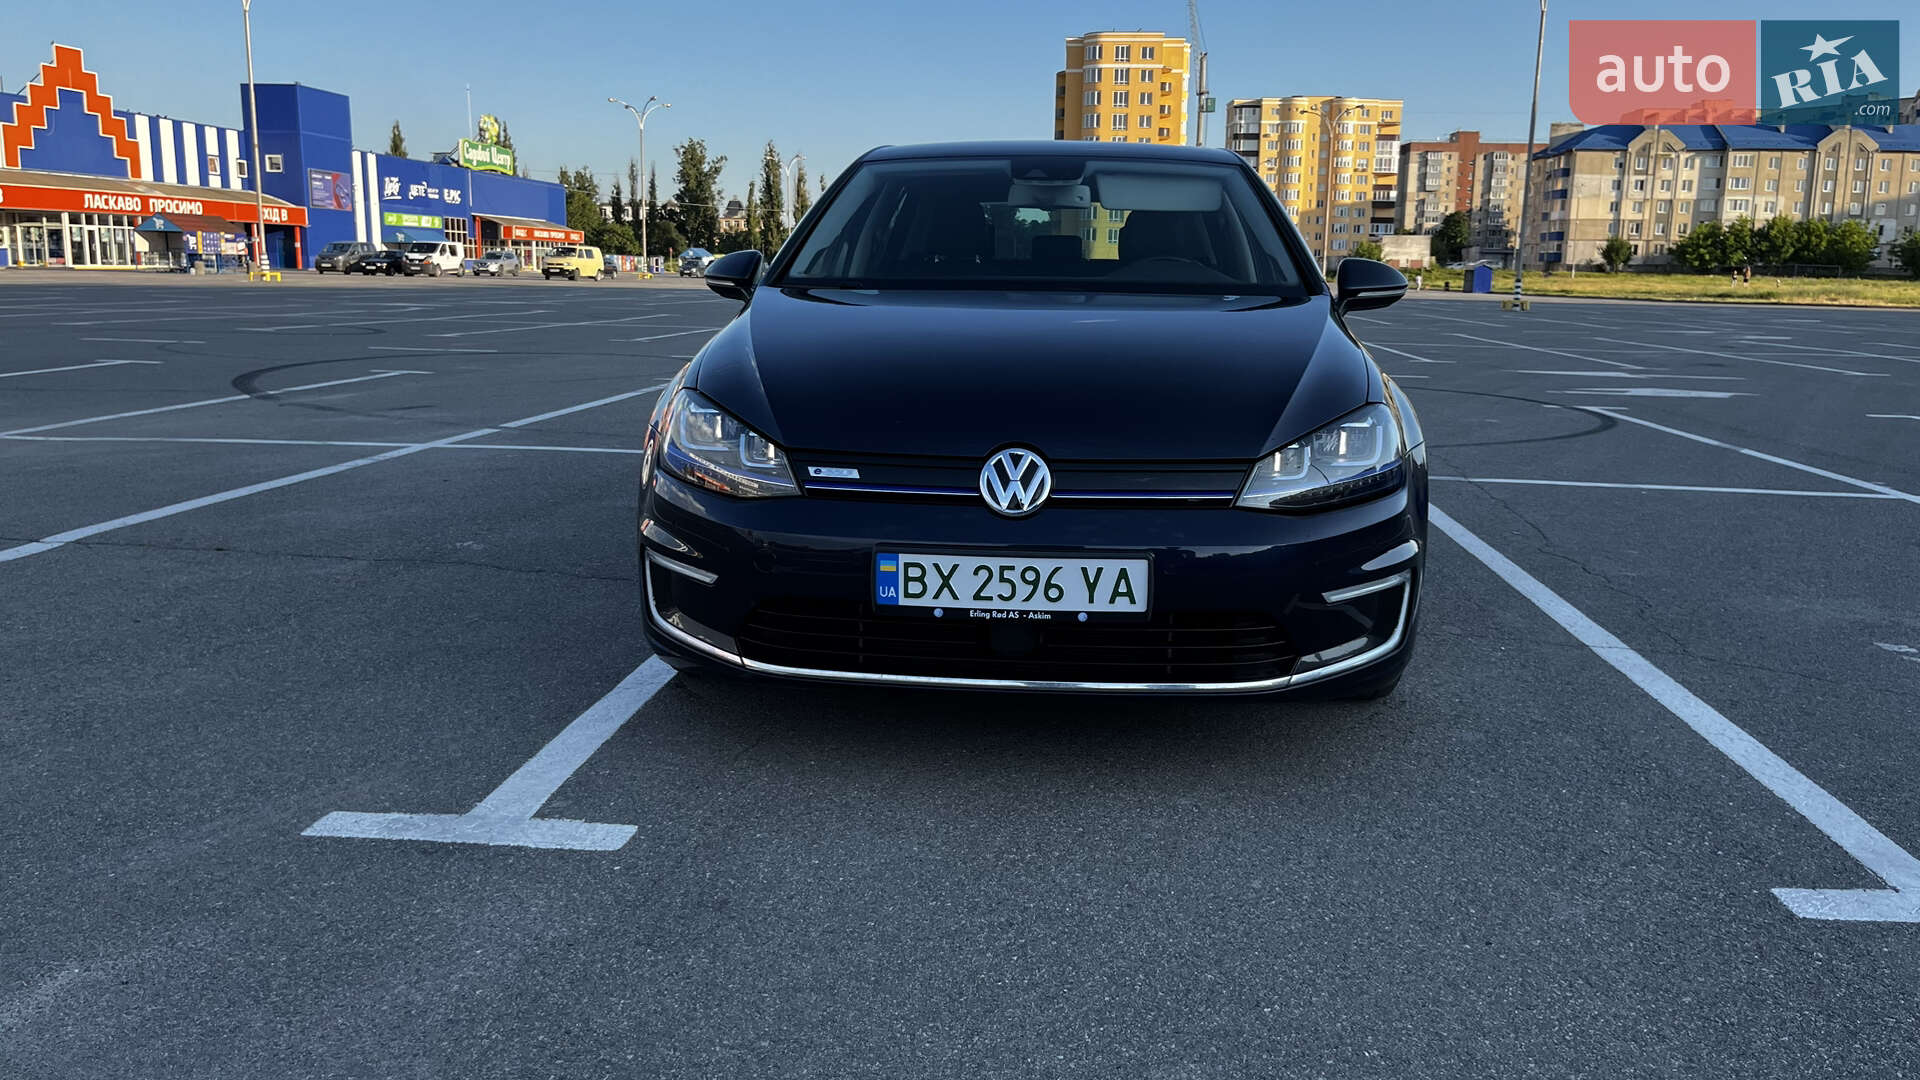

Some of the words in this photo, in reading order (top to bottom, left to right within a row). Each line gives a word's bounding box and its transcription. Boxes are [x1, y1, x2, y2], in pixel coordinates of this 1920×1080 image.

[83, 193, 142, 213] ЛАСКАВО
[149, 198, 203, 216] ПРОСИМО
[263, 207, 280, 222] ХІД
[903, 561, 960, 601] BX
[972, 564, 1065, 603] 2596
[1080, 566, 1137, 605] YA
[879, 586, 897, 598] UA
[969, 610, 990, 620] Erling
[1008, 611, 1019, 619] AS
[1029, 611, 1051, 620] Askim
